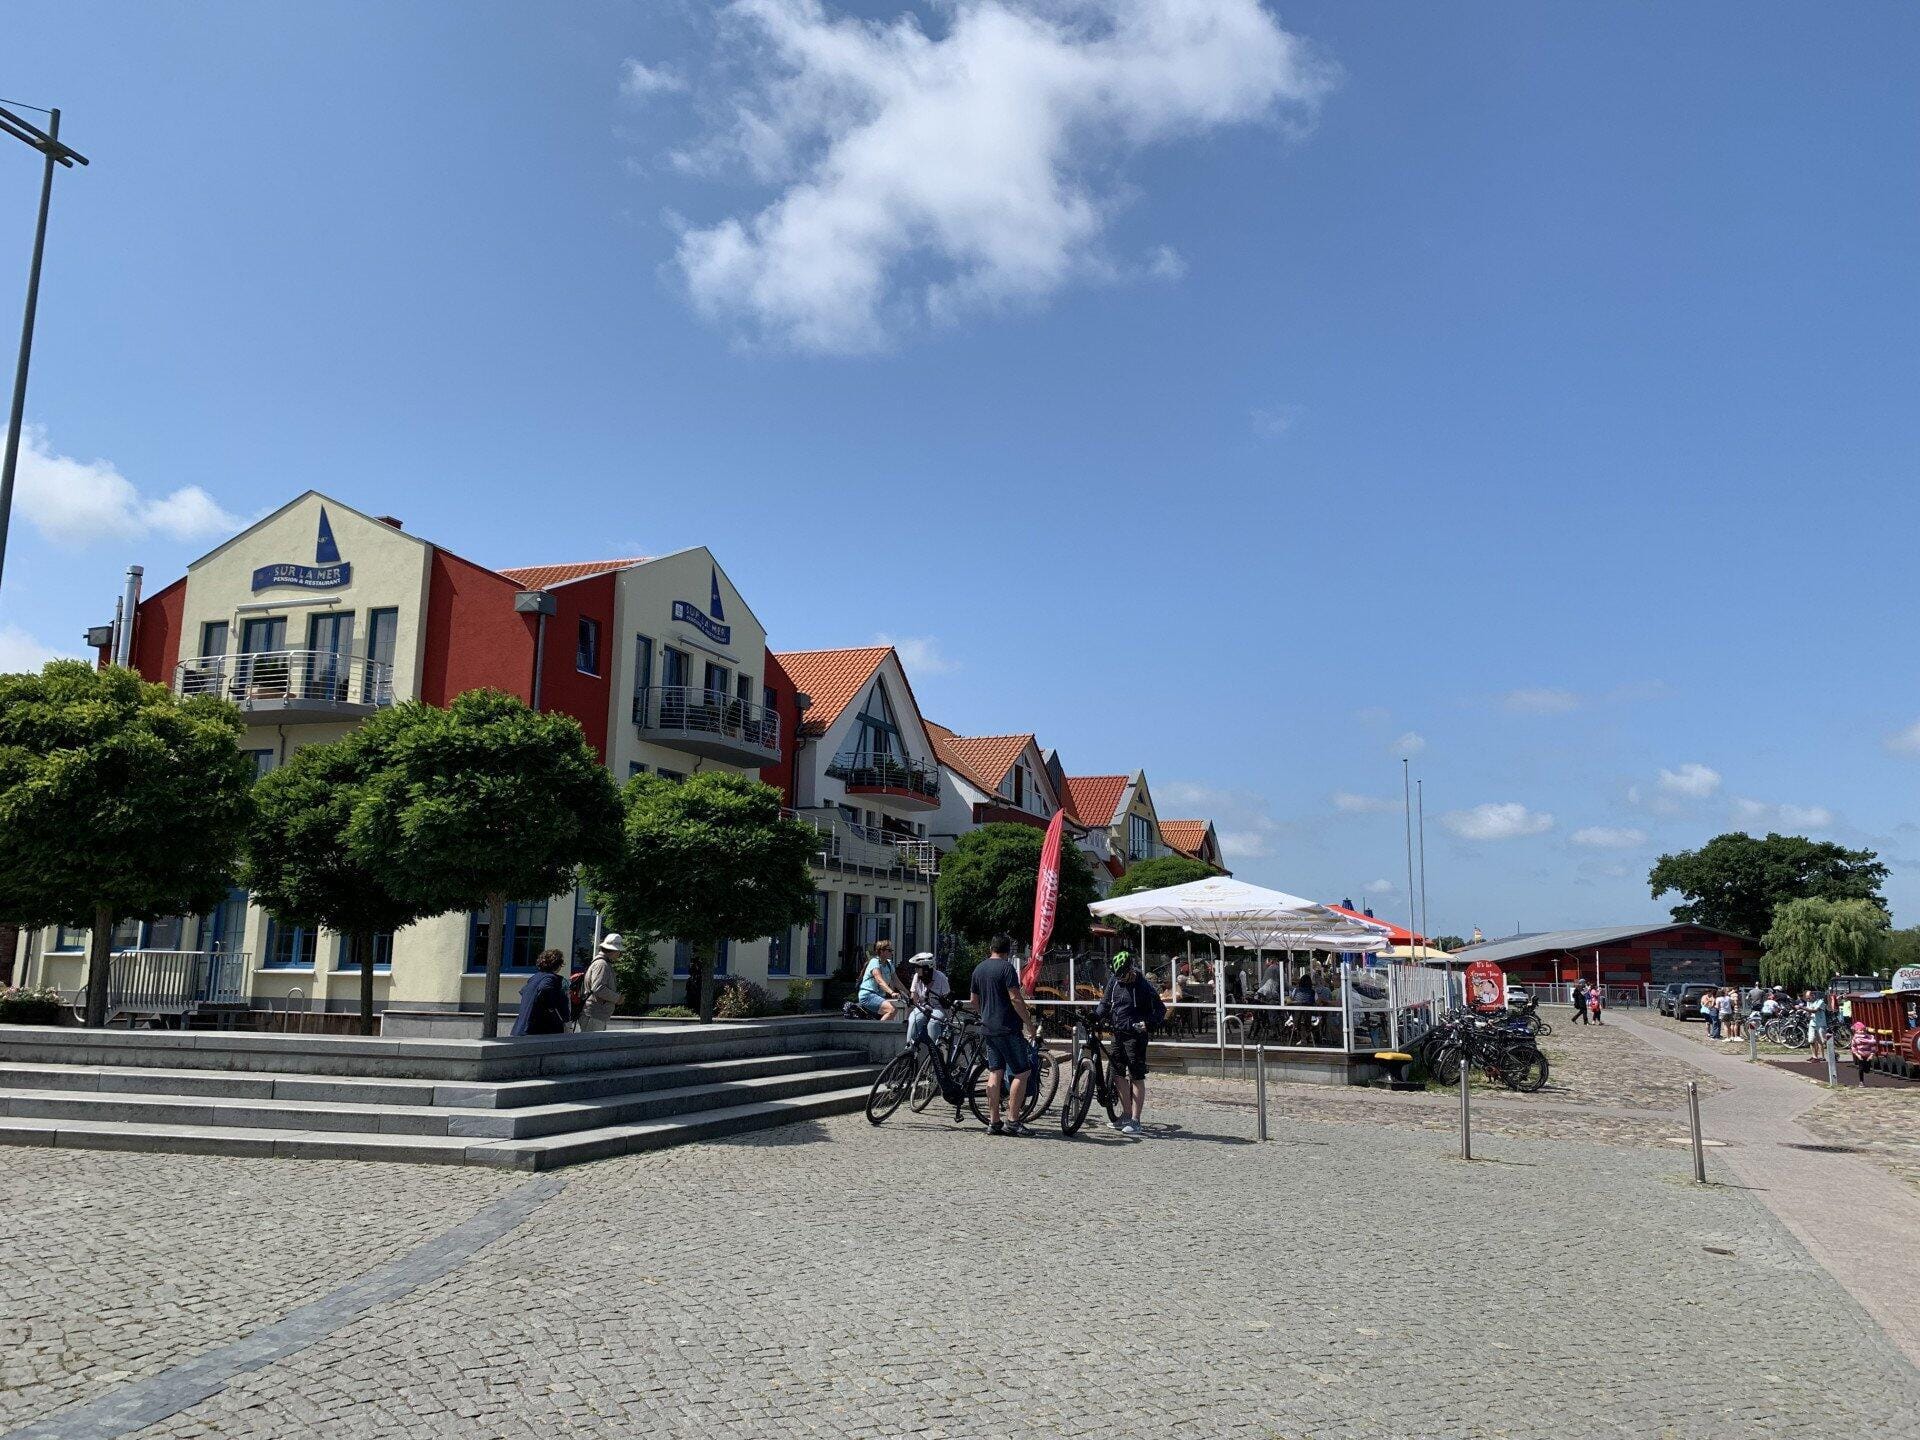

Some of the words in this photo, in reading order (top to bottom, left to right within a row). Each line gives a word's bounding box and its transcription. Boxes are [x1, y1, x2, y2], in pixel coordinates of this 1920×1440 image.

[274, 565, 296, 577] SUR
[299, 567, 313, 580] LA
[316, 568, 341, 580] MER
[304, 578, 341, 586] RESTAURANT
